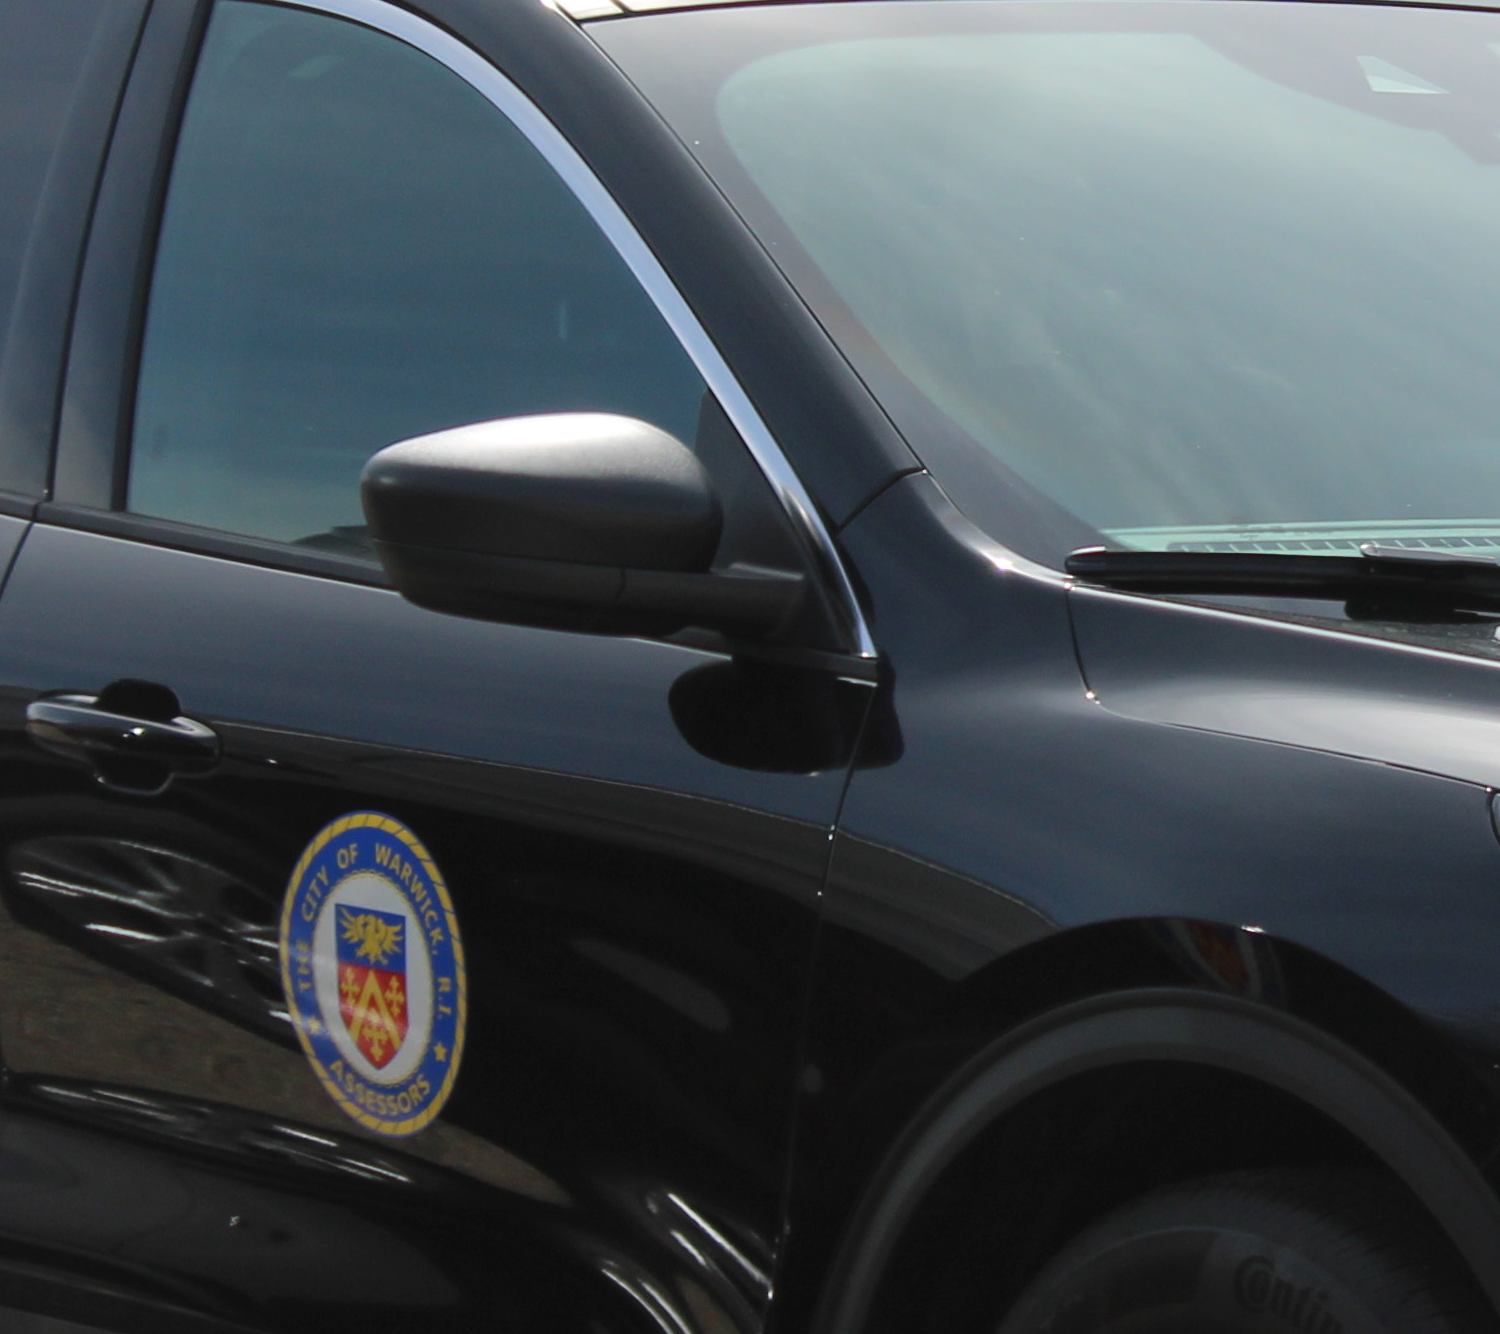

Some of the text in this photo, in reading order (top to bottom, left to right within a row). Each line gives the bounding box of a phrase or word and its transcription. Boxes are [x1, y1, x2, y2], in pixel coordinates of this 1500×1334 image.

[302, 865, 328, 921] CITY
[337, 843, 358, 869] OF
[331, 1059, 430, 1116] ASSESSORS
